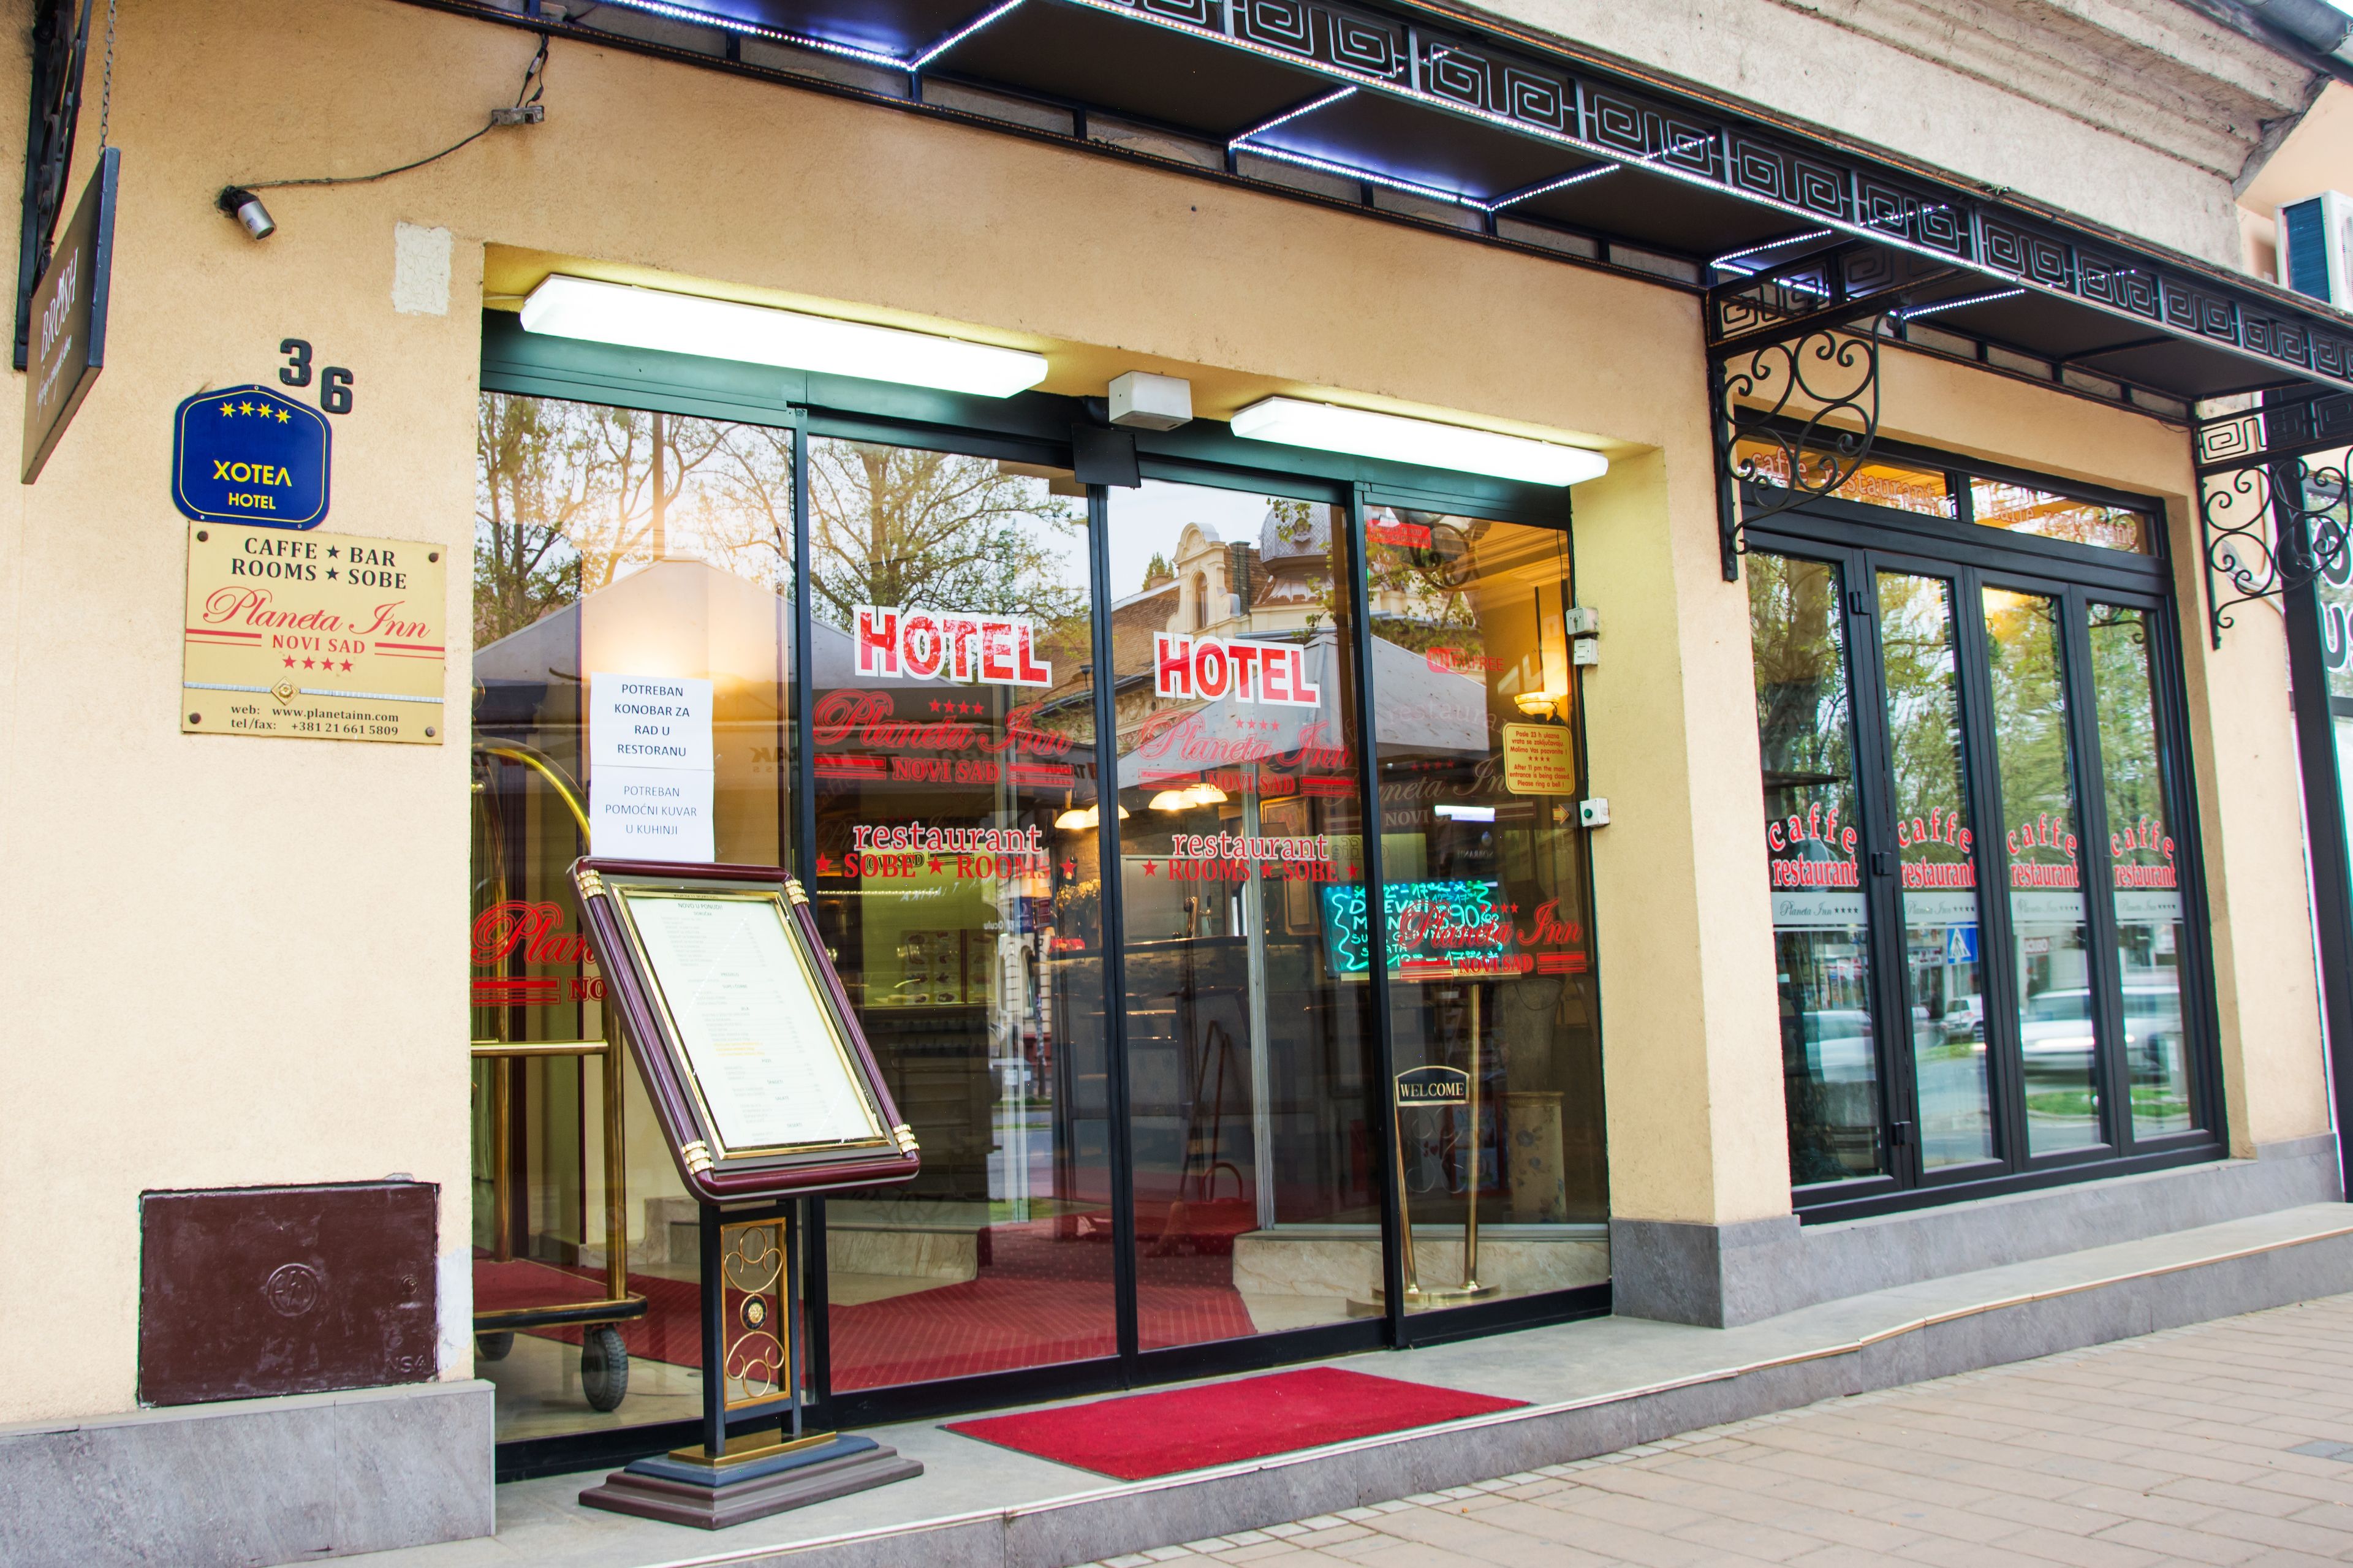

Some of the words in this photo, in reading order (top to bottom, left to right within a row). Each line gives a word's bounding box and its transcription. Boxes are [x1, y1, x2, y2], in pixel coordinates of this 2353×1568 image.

[213, 460, 292, 487] ХОТЕЛ
[228, 492, 276, 510] HOTEL
[244, 537, 318, 559] CAFFE
[349, 547, 396, 567] BAR
[230, 558, 317, 581] ROOMS
[348, 569, 407, 589] SOBE
[203, 586, 344, 632] Planeta
[349, 600, 431, 639] Inn
[273, 634, 320, 651] NOVI
[328, 638, 366, 654] SAD
[854, 605, 1053, 687] HOTEL
[1153, 632, 1320, 708] HOTEL
[1472, 656, 1505, 672] FREE
[622, 684, 684, 697] POTREBAN
[231, 704, 260, 714] web:
[272, 708, 400, 722] www.planetainn.com
[615, 703, 672, 716] KONOBAR
[675, 707, 690, 718] ZA
[813, 688, 979, 750] Planeta
[977, 703, 1074, 756] Inn
[291, 722, 321, 732] +381
[325, 722, 339, 733] 21
[343, 724, 365, 734] 661
[369, 725, 399, 736] 5809
[634, 725, 658, 735] RAD
[662, 727, 670, 736] U
[1137, 710, 1273, 763] Planeta
[1267, 719, 1355, 768] Inn
[618, 744, 687, 757] RESTORANU
[892, 756, 952, 784] NOVI
[954, 759, 1001, 785] SAD
[1205, 771, 1256, 793] NOVI
[1259, 772, 1295, 796] SAD
[624, 786, 680, 797] POTREBAN
[1536, 780, 1545, 789] ring
[605, 803, 658, 816] POMOĆNI
[661, 806, 697, 817] KUVAR
[1384, 809, 1428, 827] NOVI
[626, 825, 633, 834] U
[637, 825, 678, 835] KUHINJI
[853, 820, 1044, 854] restaurant
[1768, 801, 1858, 854] caffe
[1898, 806, 1973, 854] caffe
[2007, 812, 2078, 858] caffe
[2110, 814, 2175, 859] caffe
[1172, 831, 1329, 862] restaurant
[844, 854, 917, 879] SOBE
[957, 856, 1051, 879] ROOMS
[1168, 859, 1251, 882] ROOMS
[1283, 860, 1338, 883] SOBE
[1772, 852, 1860, 888] restaurant
[1900, 855, 1977, 888] restaurant
[2010, 857, 2080, 888] restaurant
[2114, 858, 2177, 888] restaurant
[1780, 900, 1812, 917] Planeta
[1813, 901, 1832, 917] Inn
[471, 900, 596, 966] Plan
[1398, 899, 1515, 950] Planeta
[1516, 898, 1583, 947] Inn
[1458, 954, 1500, 975] NOVI
[1502, 954, 1534, 974] SAD
[567, 976, 608, 1001] NO
[1400, 1082, 1464, 1097] WELCOME
